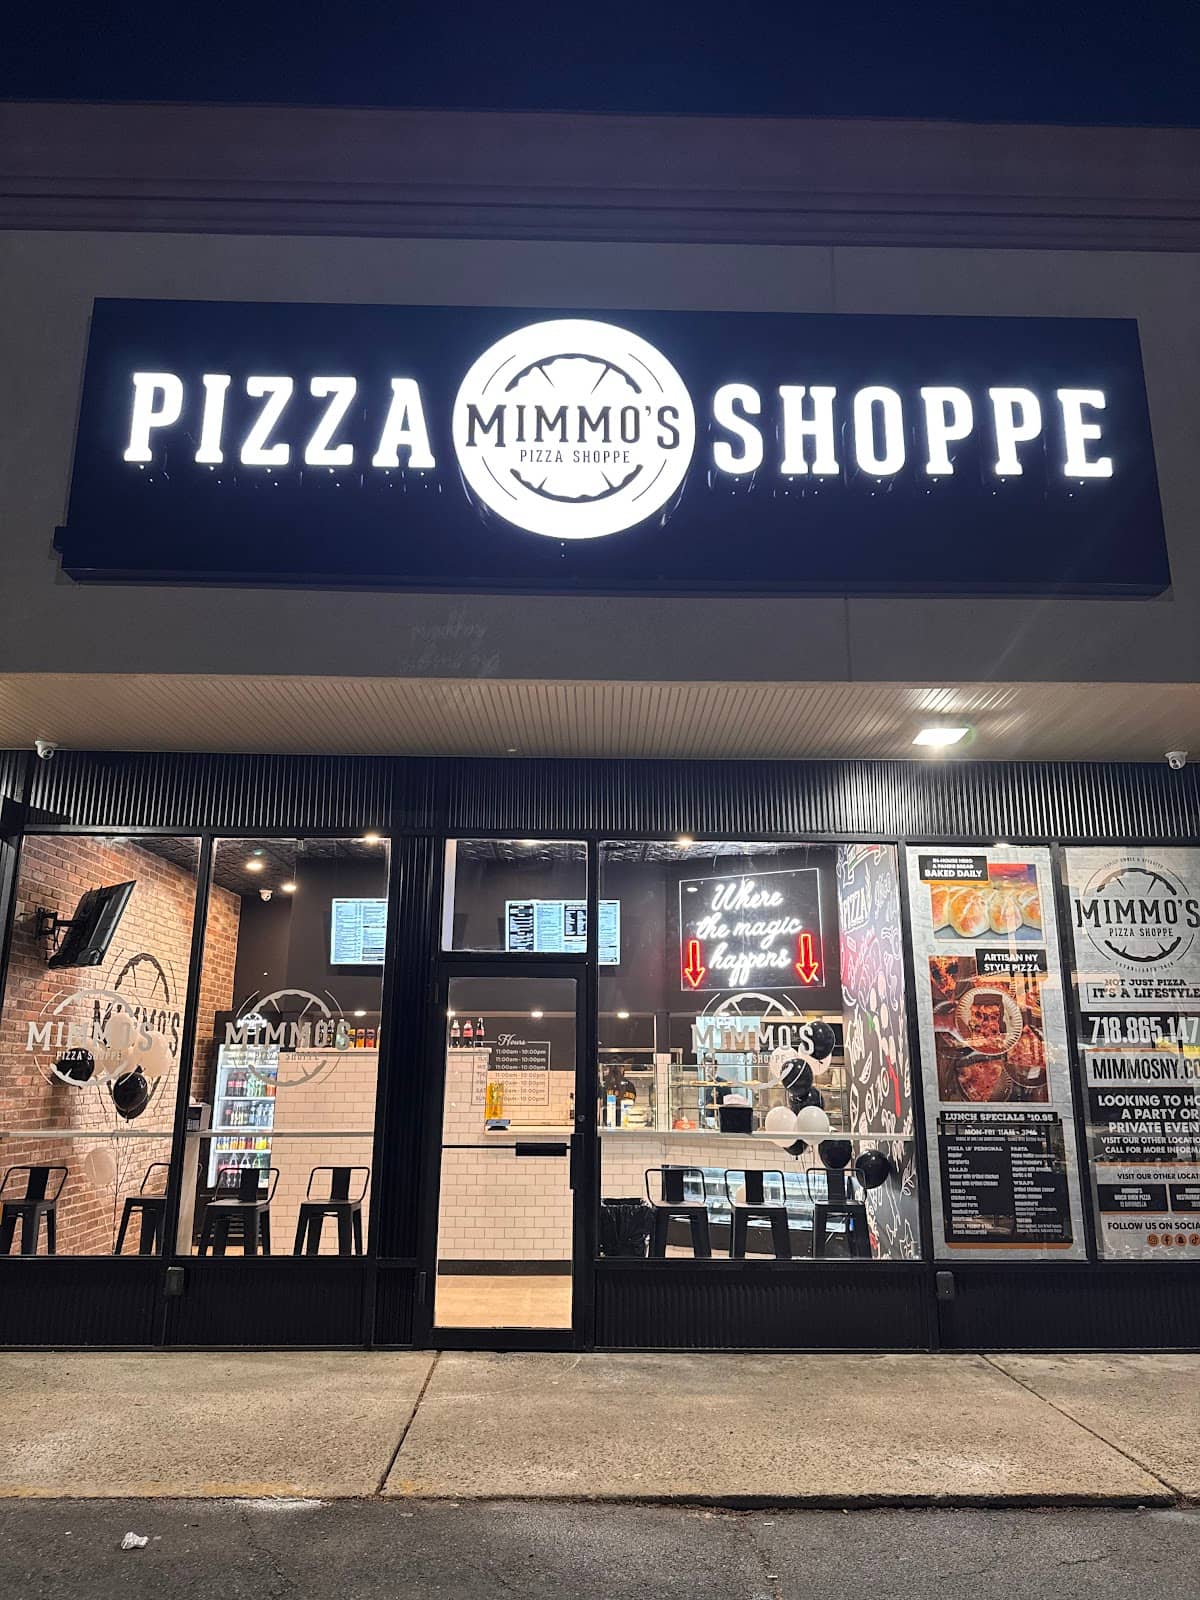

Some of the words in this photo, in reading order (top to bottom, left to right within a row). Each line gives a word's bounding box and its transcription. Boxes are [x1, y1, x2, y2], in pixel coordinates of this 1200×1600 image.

[123, 371, 436, 468] PIZZA
[465, 403, 680, 450] MIMMO'S
[713, 382, 1113, 478] SHOPPE
[520, 450, 564, 463] PIZZA
[573, 450, 630, 463] SHOPPE
[924, 869, 955, 878] BAKED
[956, 869, 983, 878] DAILY
[711, 878, 785, 912] Where
[1074, 899, 1200, 928] MIMMO'S
[696, 911, 731, 941] the
[733, 915, 804, 950] magic
[1109, 928, 1135, 937] PIZZA
[1140, 928, 1174, 937] SHOPPE
[983, 953, 1024, 962] ARTISAN
[1025, 953, 1039, 962] NY
[708, 940, 793, 988] happens
[984, 963, 1011, 972] STYLE
[1012, 963, 1041, 972] PIZZA
[1104, 978, 1125, 987] NOT
[1128, 978, 1155, 987] JUST
[1157, 978, 1187, 987] PIZZA
[1093, 988, 1117, 999] IT'S
[1120, 988, 1131, 999] A
[1133, 988, 1200, 999] LIFESTYLE
[497, 1034, 526, 1046] Hours
[690, 1023, 815, 1056] MIMMO'S
[56, 1050, 83, 1061] PIZZA
[1098, 1094, 1161, 1107] LOOKING
[1162, 1094, 1181, 1107] TO
[944, 1112, 978, 1121] LUNCH
[980, 1112, 1026, 1122] SPECIALS
[1121, 1108, 1132, 1120] A
[1134, 1108, 1177, 1120] PARTY
[1180, 1108, 1199, 1120] OR
[1108, 1121, 1162, 1134] PRIVATE
[1101, 1136, 1121, 1144] VISIT
[1122, 1136, 1140, 1144] OUR
[1141, 1136, 1167, 1144] OTHER
[1104, 1146, 1125, 1154] CALL
[1126, 1146, 1142, 1154] FOR
[1143, 1146, 1166, 1154] MORE
[1107, 1222, 1143, 1230] FOLLOW
[1145, 1222, 1157, 1230] US
[1158, 1222, 1173, 1230] ON
